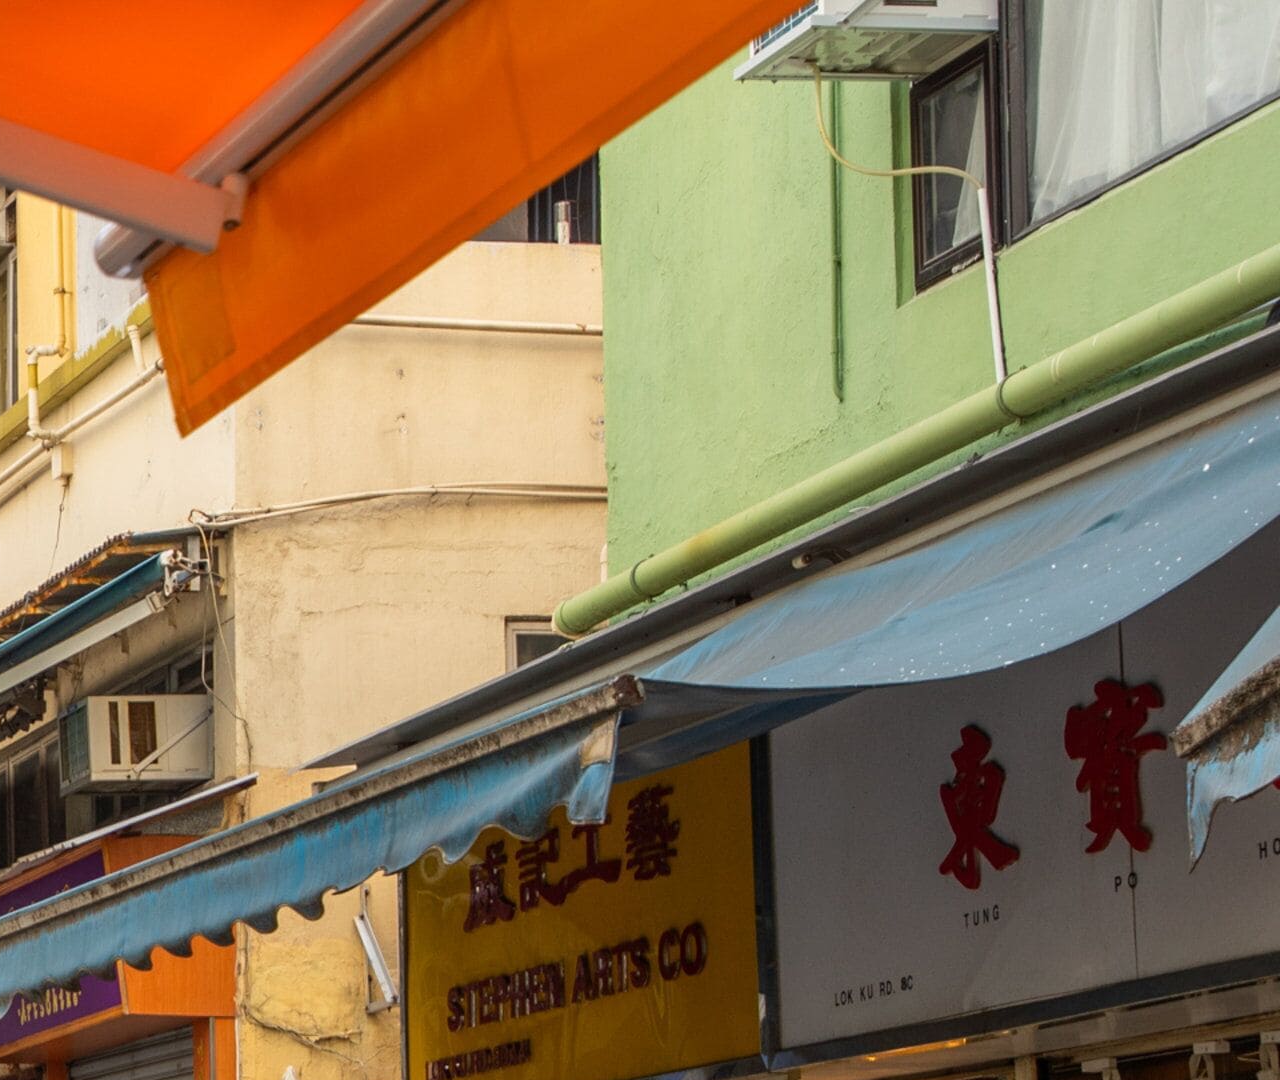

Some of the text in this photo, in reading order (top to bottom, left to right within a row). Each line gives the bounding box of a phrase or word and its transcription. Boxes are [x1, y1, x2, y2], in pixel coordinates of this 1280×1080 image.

[963, 904, 1000, 929] TUNG
[1114, 872, 1138, 892] PO
[447, 921, 708, 1033] STEPHEN ARTS CO
[834, 990, 854, 1007] LOK
[859, 983, 874, 1001] KU
